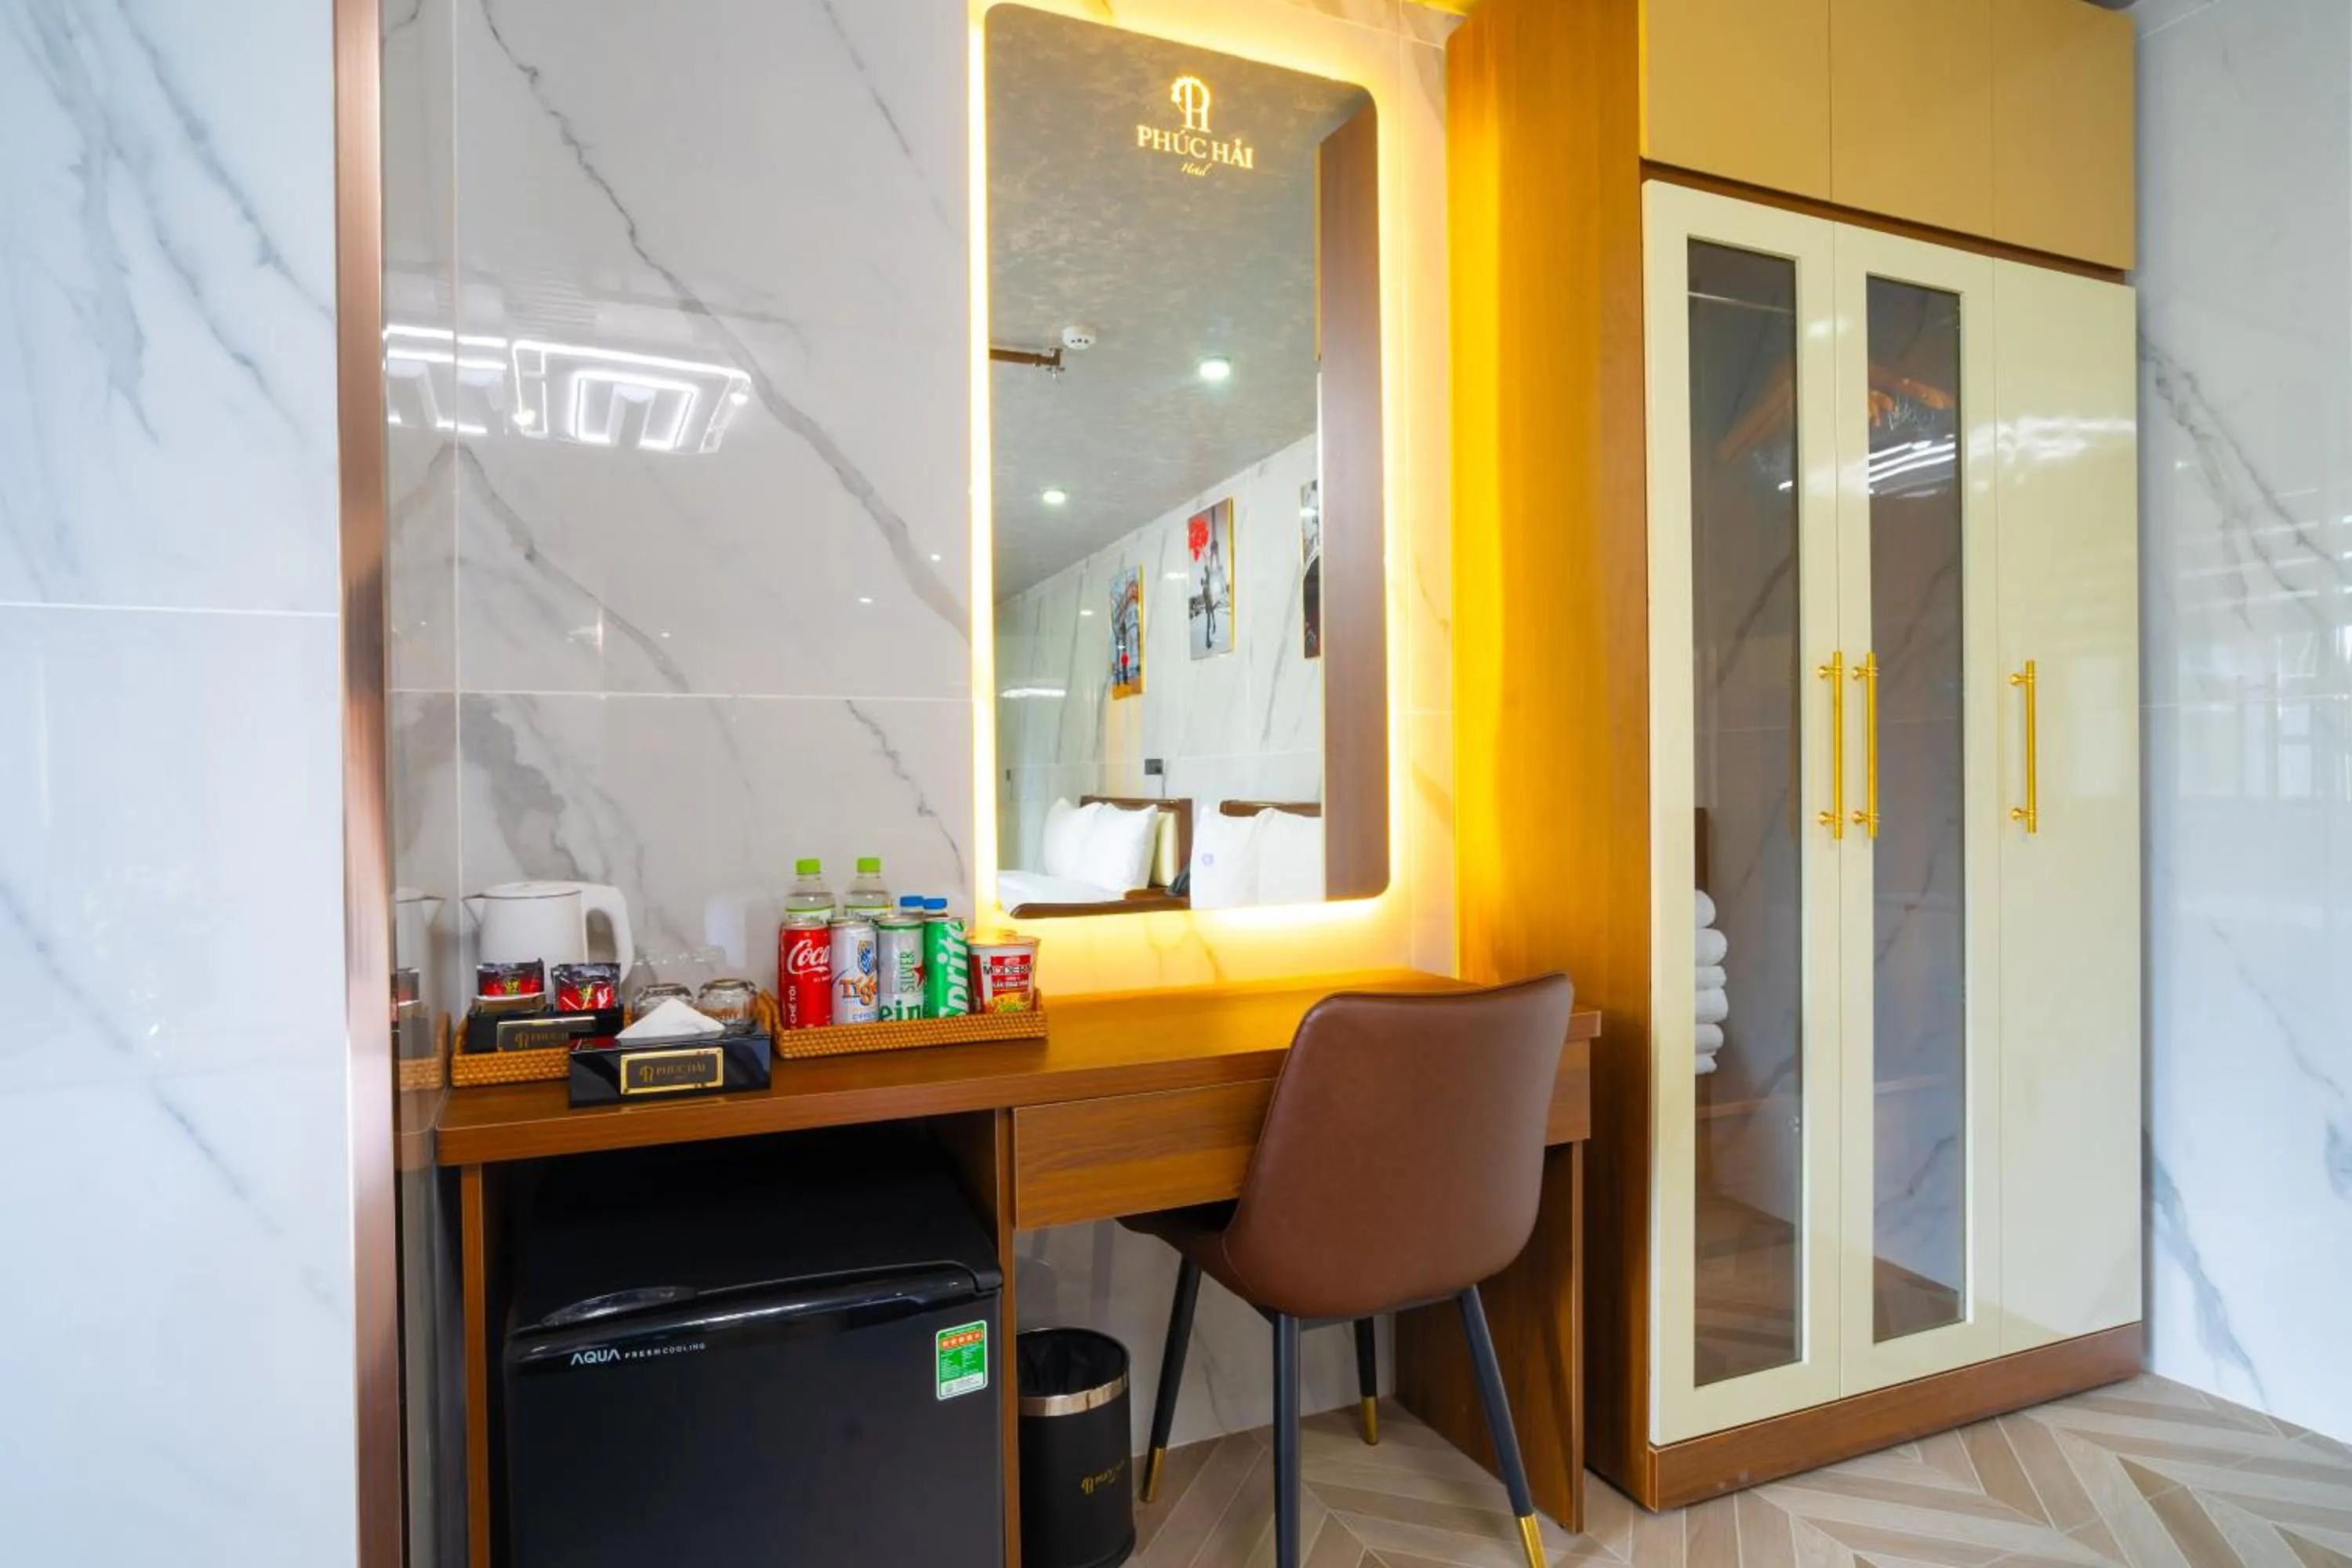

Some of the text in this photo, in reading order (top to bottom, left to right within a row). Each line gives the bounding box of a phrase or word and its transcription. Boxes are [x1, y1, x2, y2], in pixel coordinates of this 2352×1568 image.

[1137, 125, 1254, 169] PHÚC HẢI
[899, 951, 915, 993] SILVER
[571, 1348, 621, 1366] AQUA
